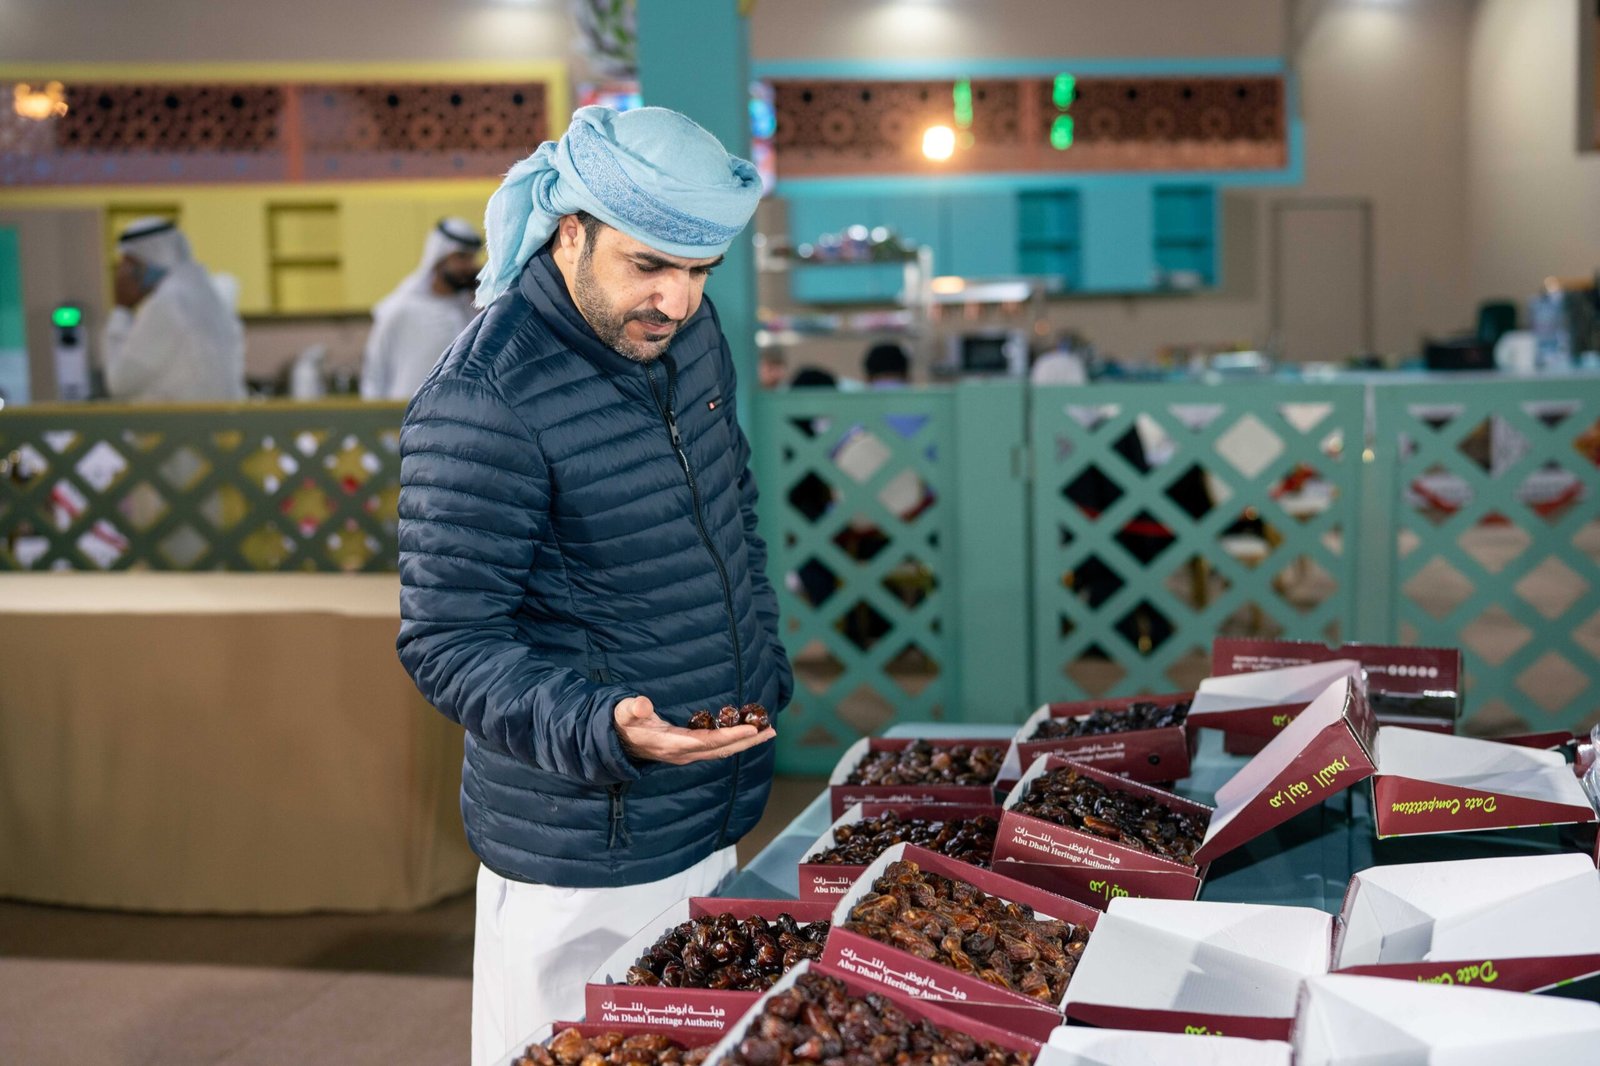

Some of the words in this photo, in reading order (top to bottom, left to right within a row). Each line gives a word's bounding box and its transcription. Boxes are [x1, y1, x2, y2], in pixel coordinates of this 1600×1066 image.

[1269, 781, 1312, 808] مزاينة
[1313, 756, 1350, 788] التمور
[1391, 796, 1460, 815] Competition
[1464, 796, 1497, 813] Date
[1012, 835, 1028, 846] Abu
[1028, 840, 1050, 853] Dhabi
[1051, 846, 1081, 863] Heritage
[837, 959, 855, 972] Abu
[857, 965, 883, 982] Dhabi
[884, 974, 920, 995] Heritage
[1456, 960, 1499, 985] Date
[602, 1013, 620, 1022] Abu
[621, 1014, 646, 1024] Dhabi
[647, 1016, 683, 1027] Heritage
[685, 1017, 725, 1030] Authority
